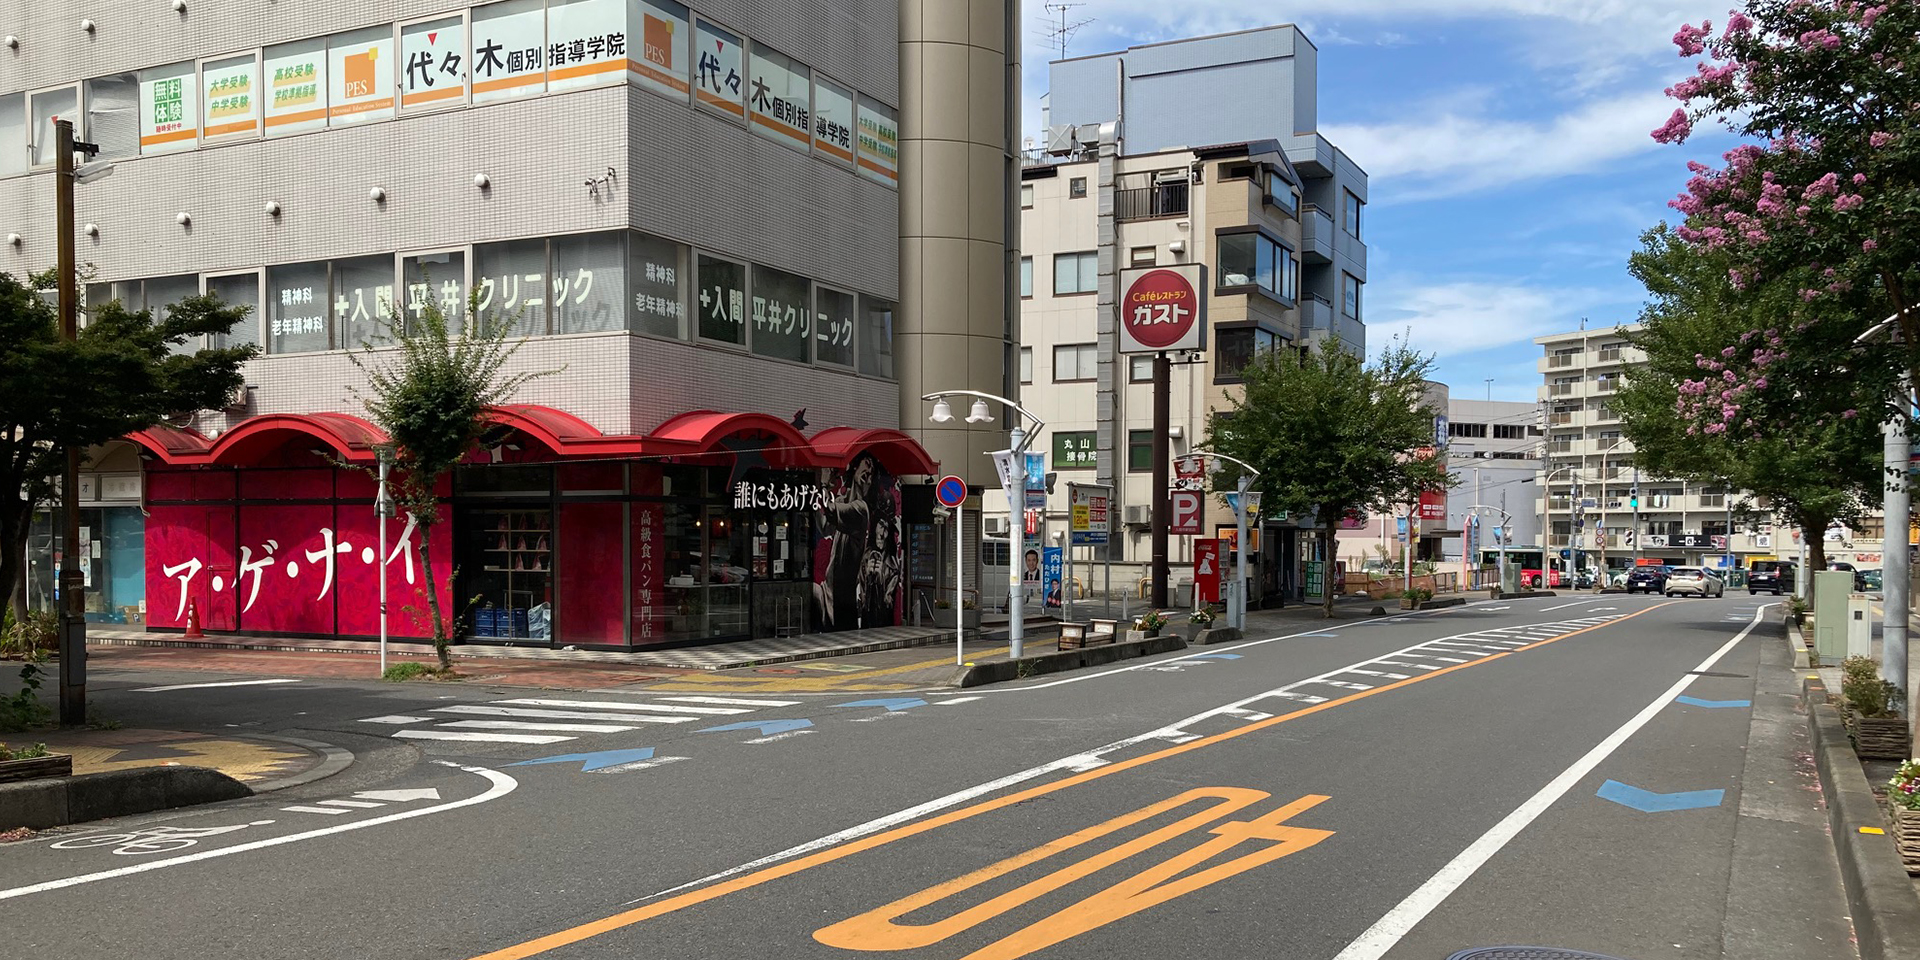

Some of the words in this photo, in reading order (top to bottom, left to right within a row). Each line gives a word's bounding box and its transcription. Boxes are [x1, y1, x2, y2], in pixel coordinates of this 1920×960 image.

[406, 32, 625, 90] 代々木個別指導学院
[645, 42, 665, 65] PES
[210, 74, 248, 92] 大学受験
[274, 63, 315, 81] 高校受験
[154, 78, 182, 102] 無料
[346, 79, 367, 97] PES
[698, 50, 850, 149] 代々木個別指導学院
[154, 100, 182, 124] 体験
[211, 95, 248, 112] 中学受験
[645, 262, 675, 287] 精神科
[281, 287, 313, 307] 精神科
[635, 292, 685, 319] 老年精神科
[1132, 290, 1187, 302] Caféレストラン
[271, 315, 323, 337] 老年精神科
[711, 285, 853, 347] 入間平井クリニック
[1133, 303, 1189, 326] ガスト
[734, 481, 835, 511] 誰にもあげない
[162, 511, 419, 622] ア・ゲ・ナ・イ
[640, 509, 652, 638] 高級食パン専門店
[1050, 553, 1060, 575] 内村
